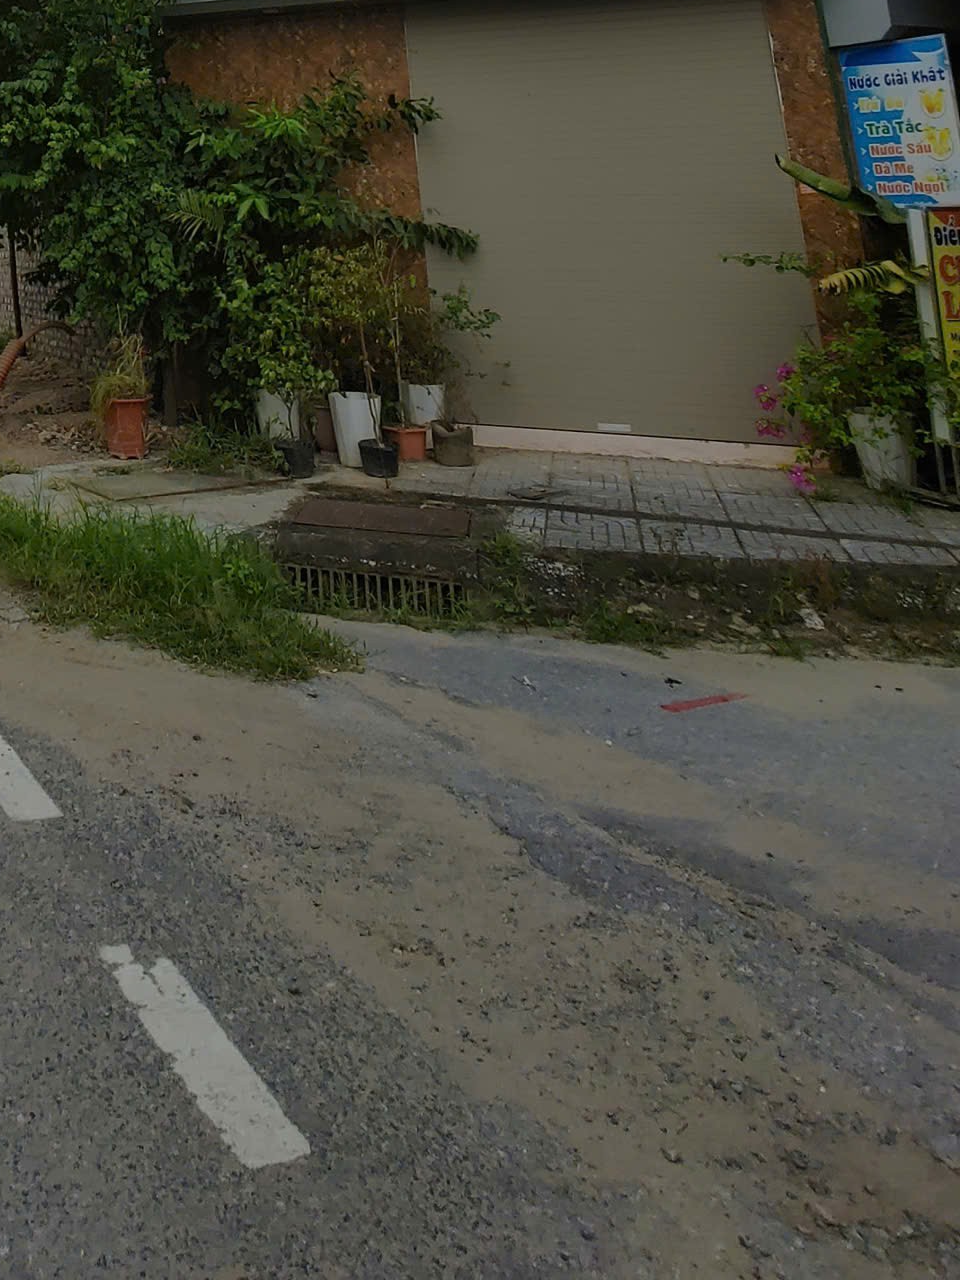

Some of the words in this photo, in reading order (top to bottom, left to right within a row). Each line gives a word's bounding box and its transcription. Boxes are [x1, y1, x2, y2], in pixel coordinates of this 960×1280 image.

[848, 74, 881, 90] Nước
[884, 68, 908, 86] Giải
[866, 121, 890, 135] Trà
